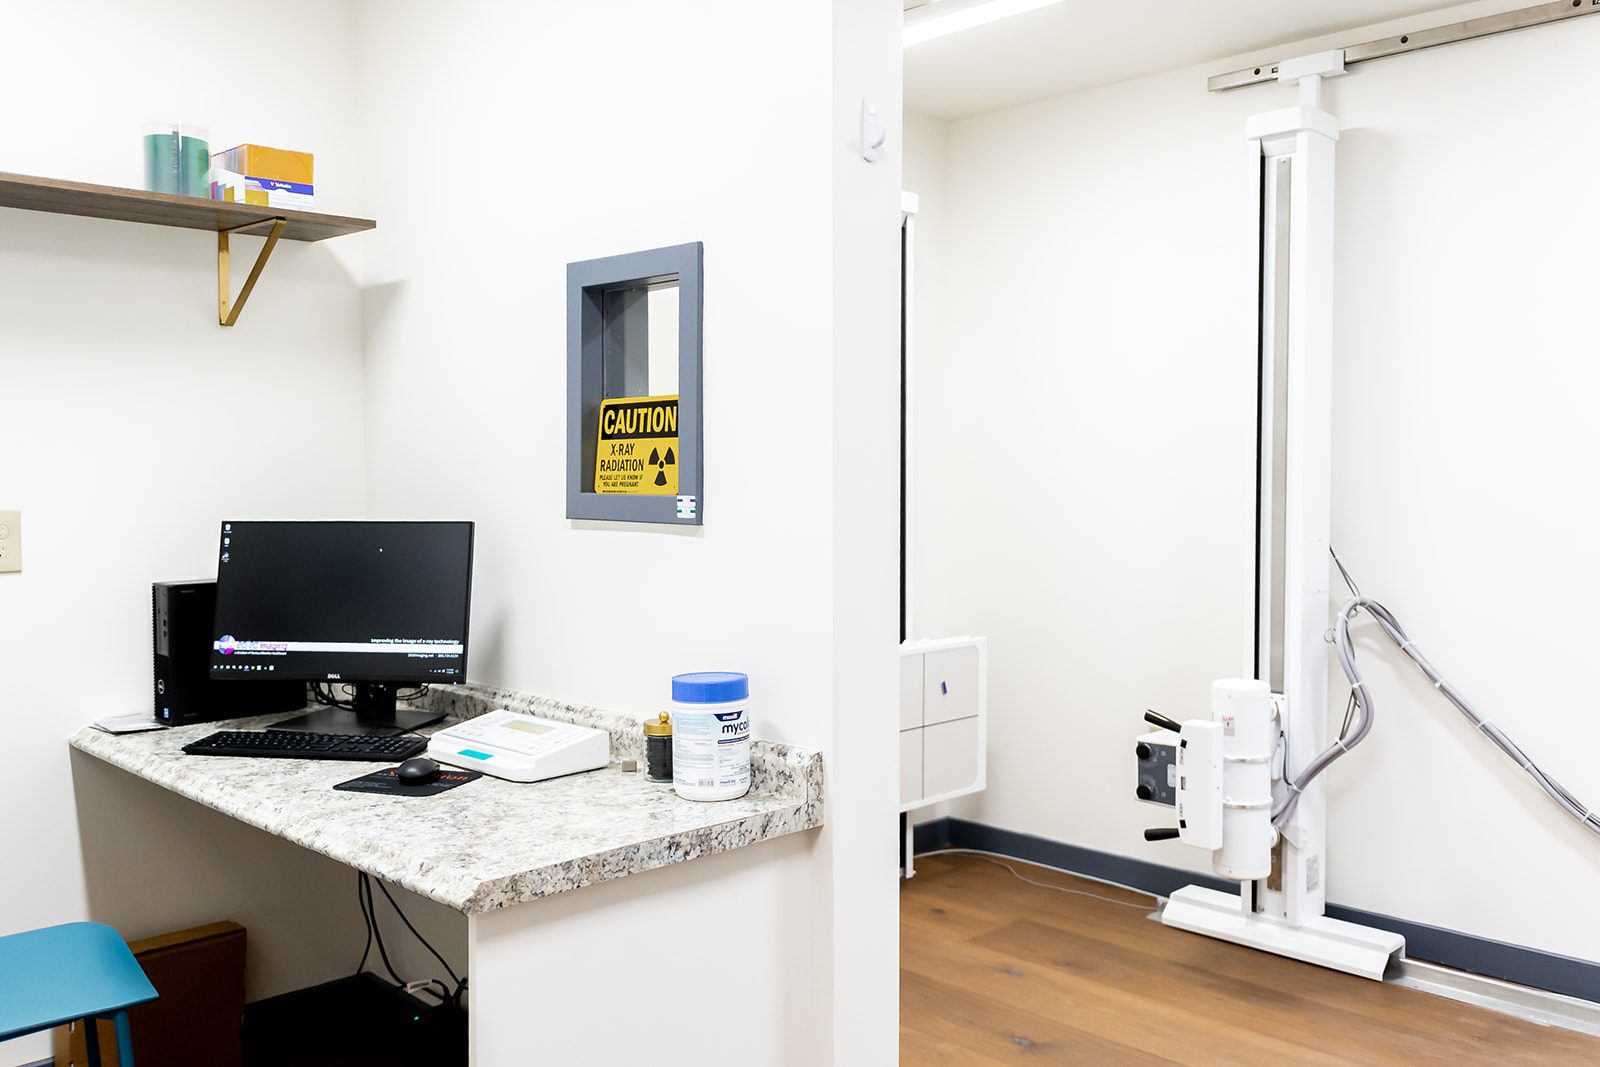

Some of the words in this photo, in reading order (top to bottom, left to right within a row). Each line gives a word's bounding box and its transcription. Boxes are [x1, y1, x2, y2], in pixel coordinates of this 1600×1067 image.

[604, 406, 677, 434] CAUTION
[610, 443, 635, 456] X-RAY
[600, 458, 644, 472] RADIATION
